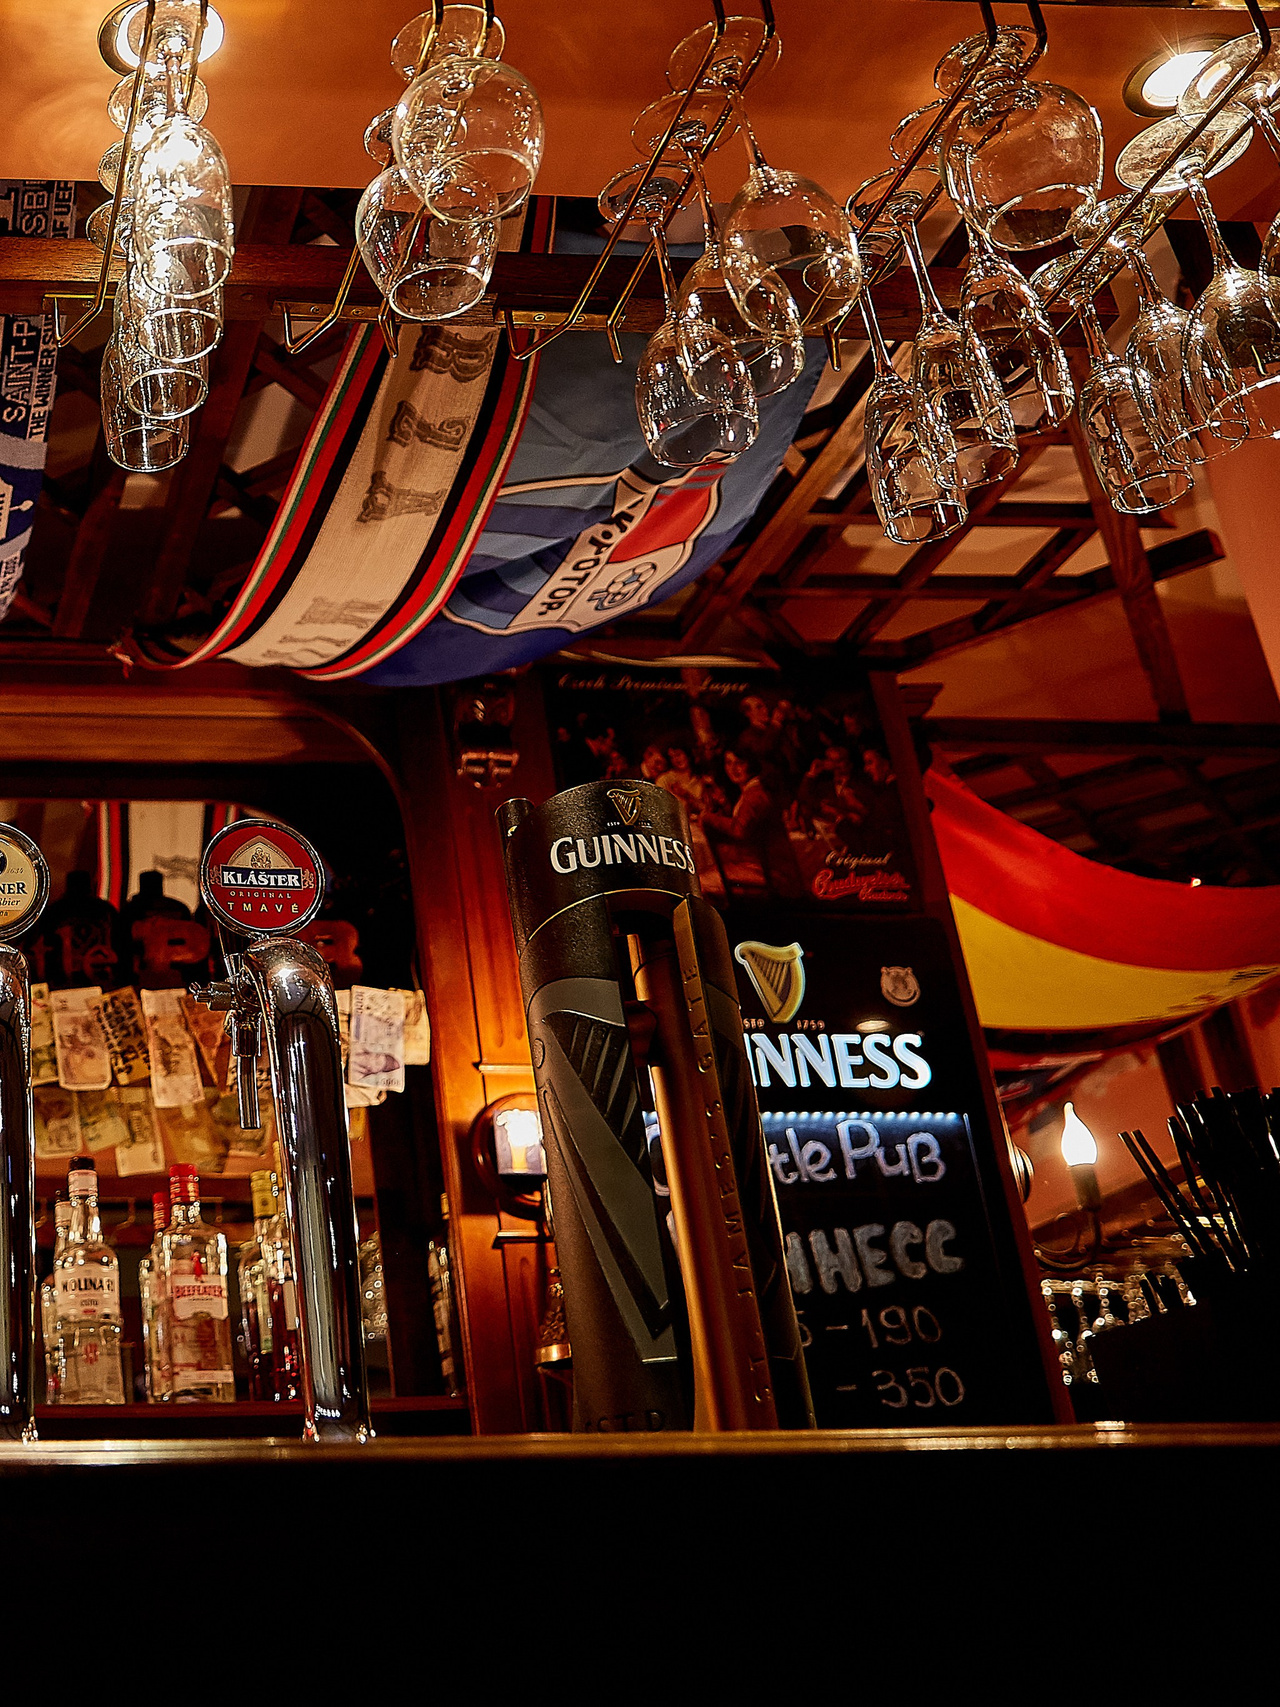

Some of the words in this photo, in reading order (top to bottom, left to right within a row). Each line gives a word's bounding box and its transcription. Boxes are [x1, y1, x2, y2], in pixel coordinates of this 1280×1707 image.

[549, 834, 696, 875] GUINNESS
[223, 870, 301, 887] KLÁŠTER
[229, 891, 292, 899] ORIGINAL
[227, 902, 299, 914] TMAVÉ
[796, 1018, 827, 1031] 1759
